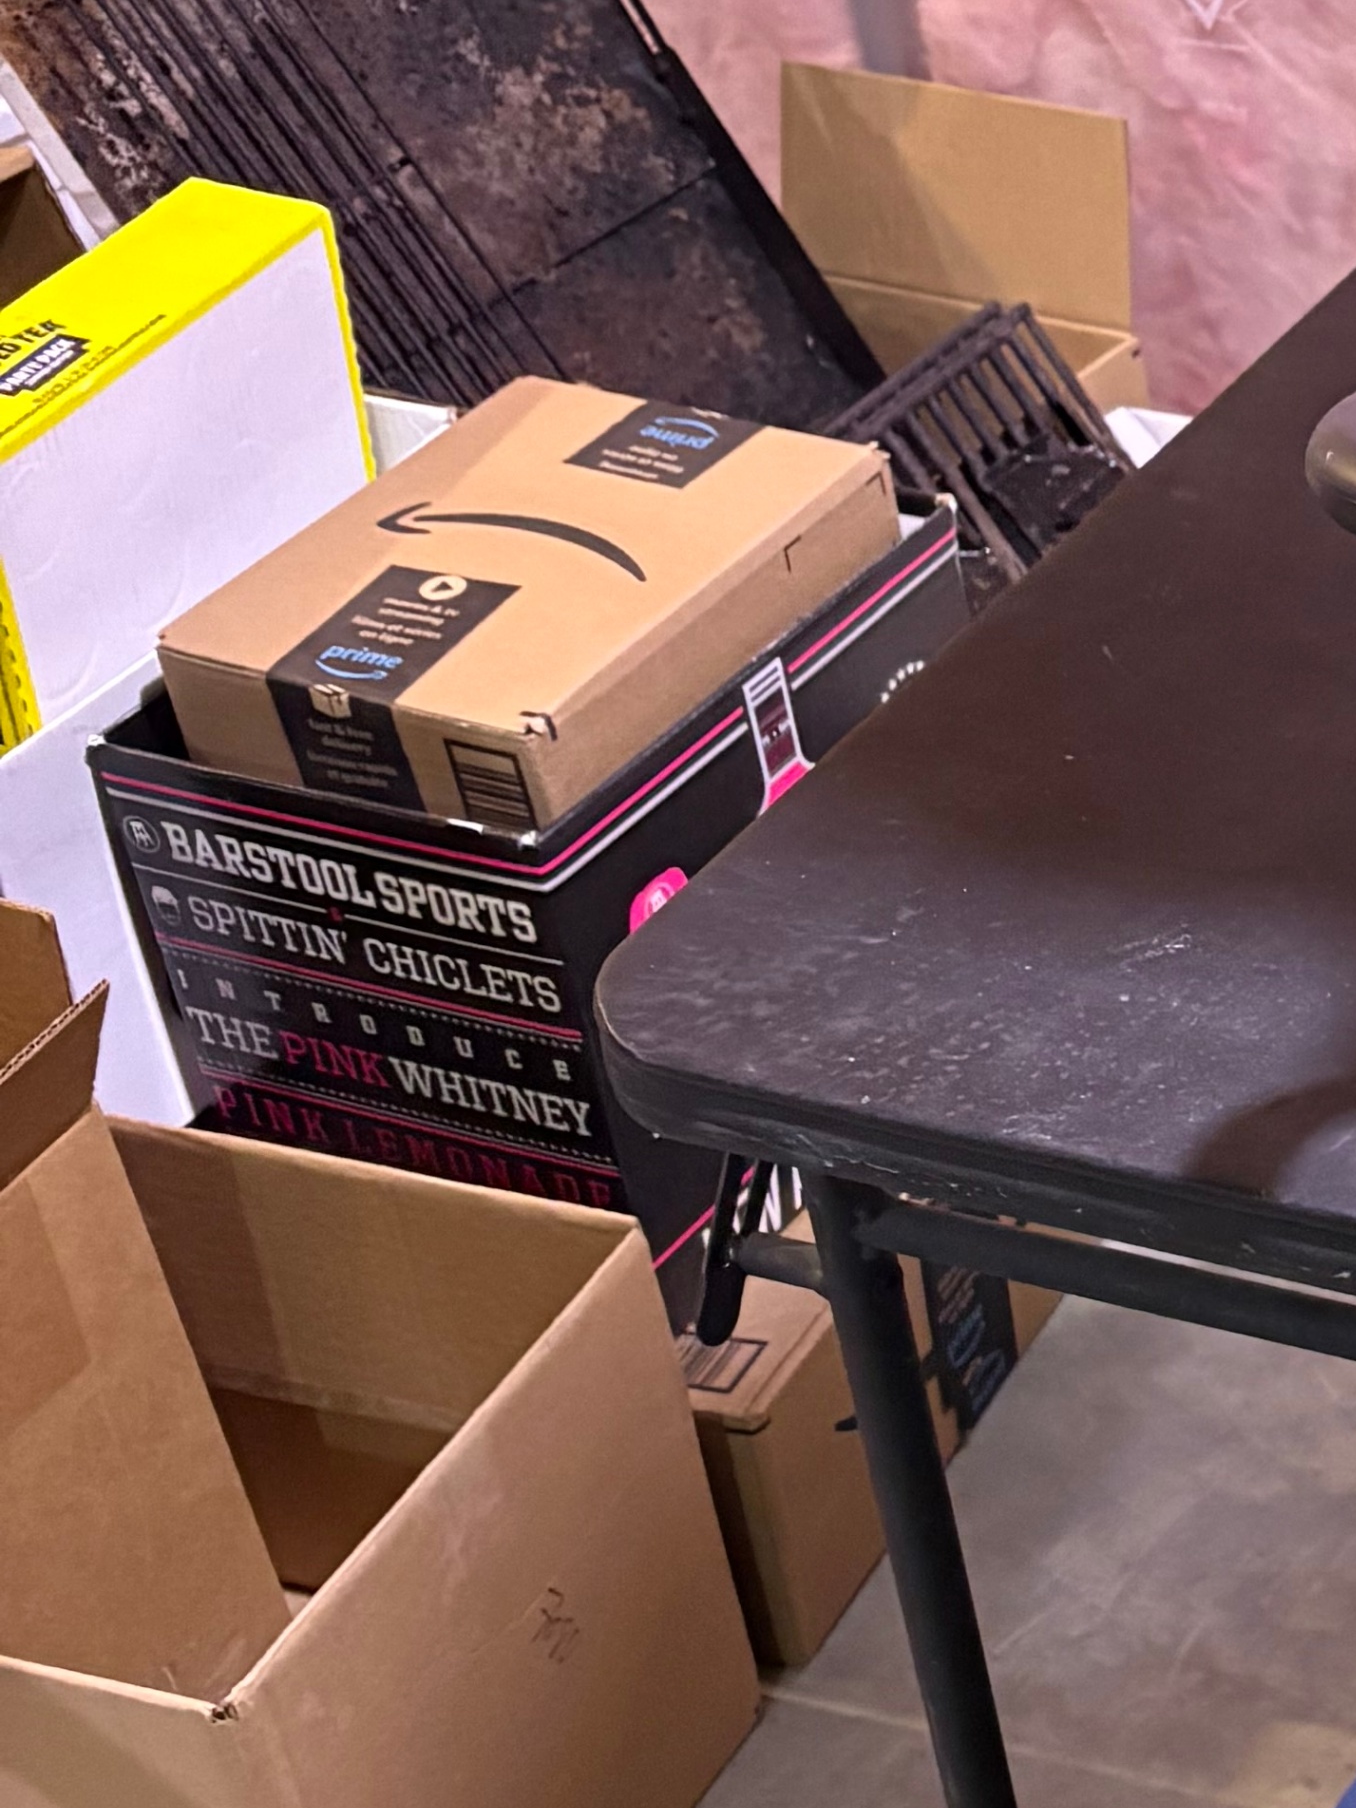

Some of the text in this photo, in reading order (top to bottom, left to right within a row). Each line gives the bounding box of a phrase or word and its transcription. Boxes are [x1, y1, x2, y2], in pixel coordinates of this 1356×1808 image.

[319, 645, 403, 668] prime
[161, 821, 538, 944] BARSTOOL SPORTS
[188, 896, 562, 1014] SPITTIN' CHICLETS
[186, 1006, 592, 1137] THE PINK WHITNEY
[214, 1085, 329, 1142] PINK
